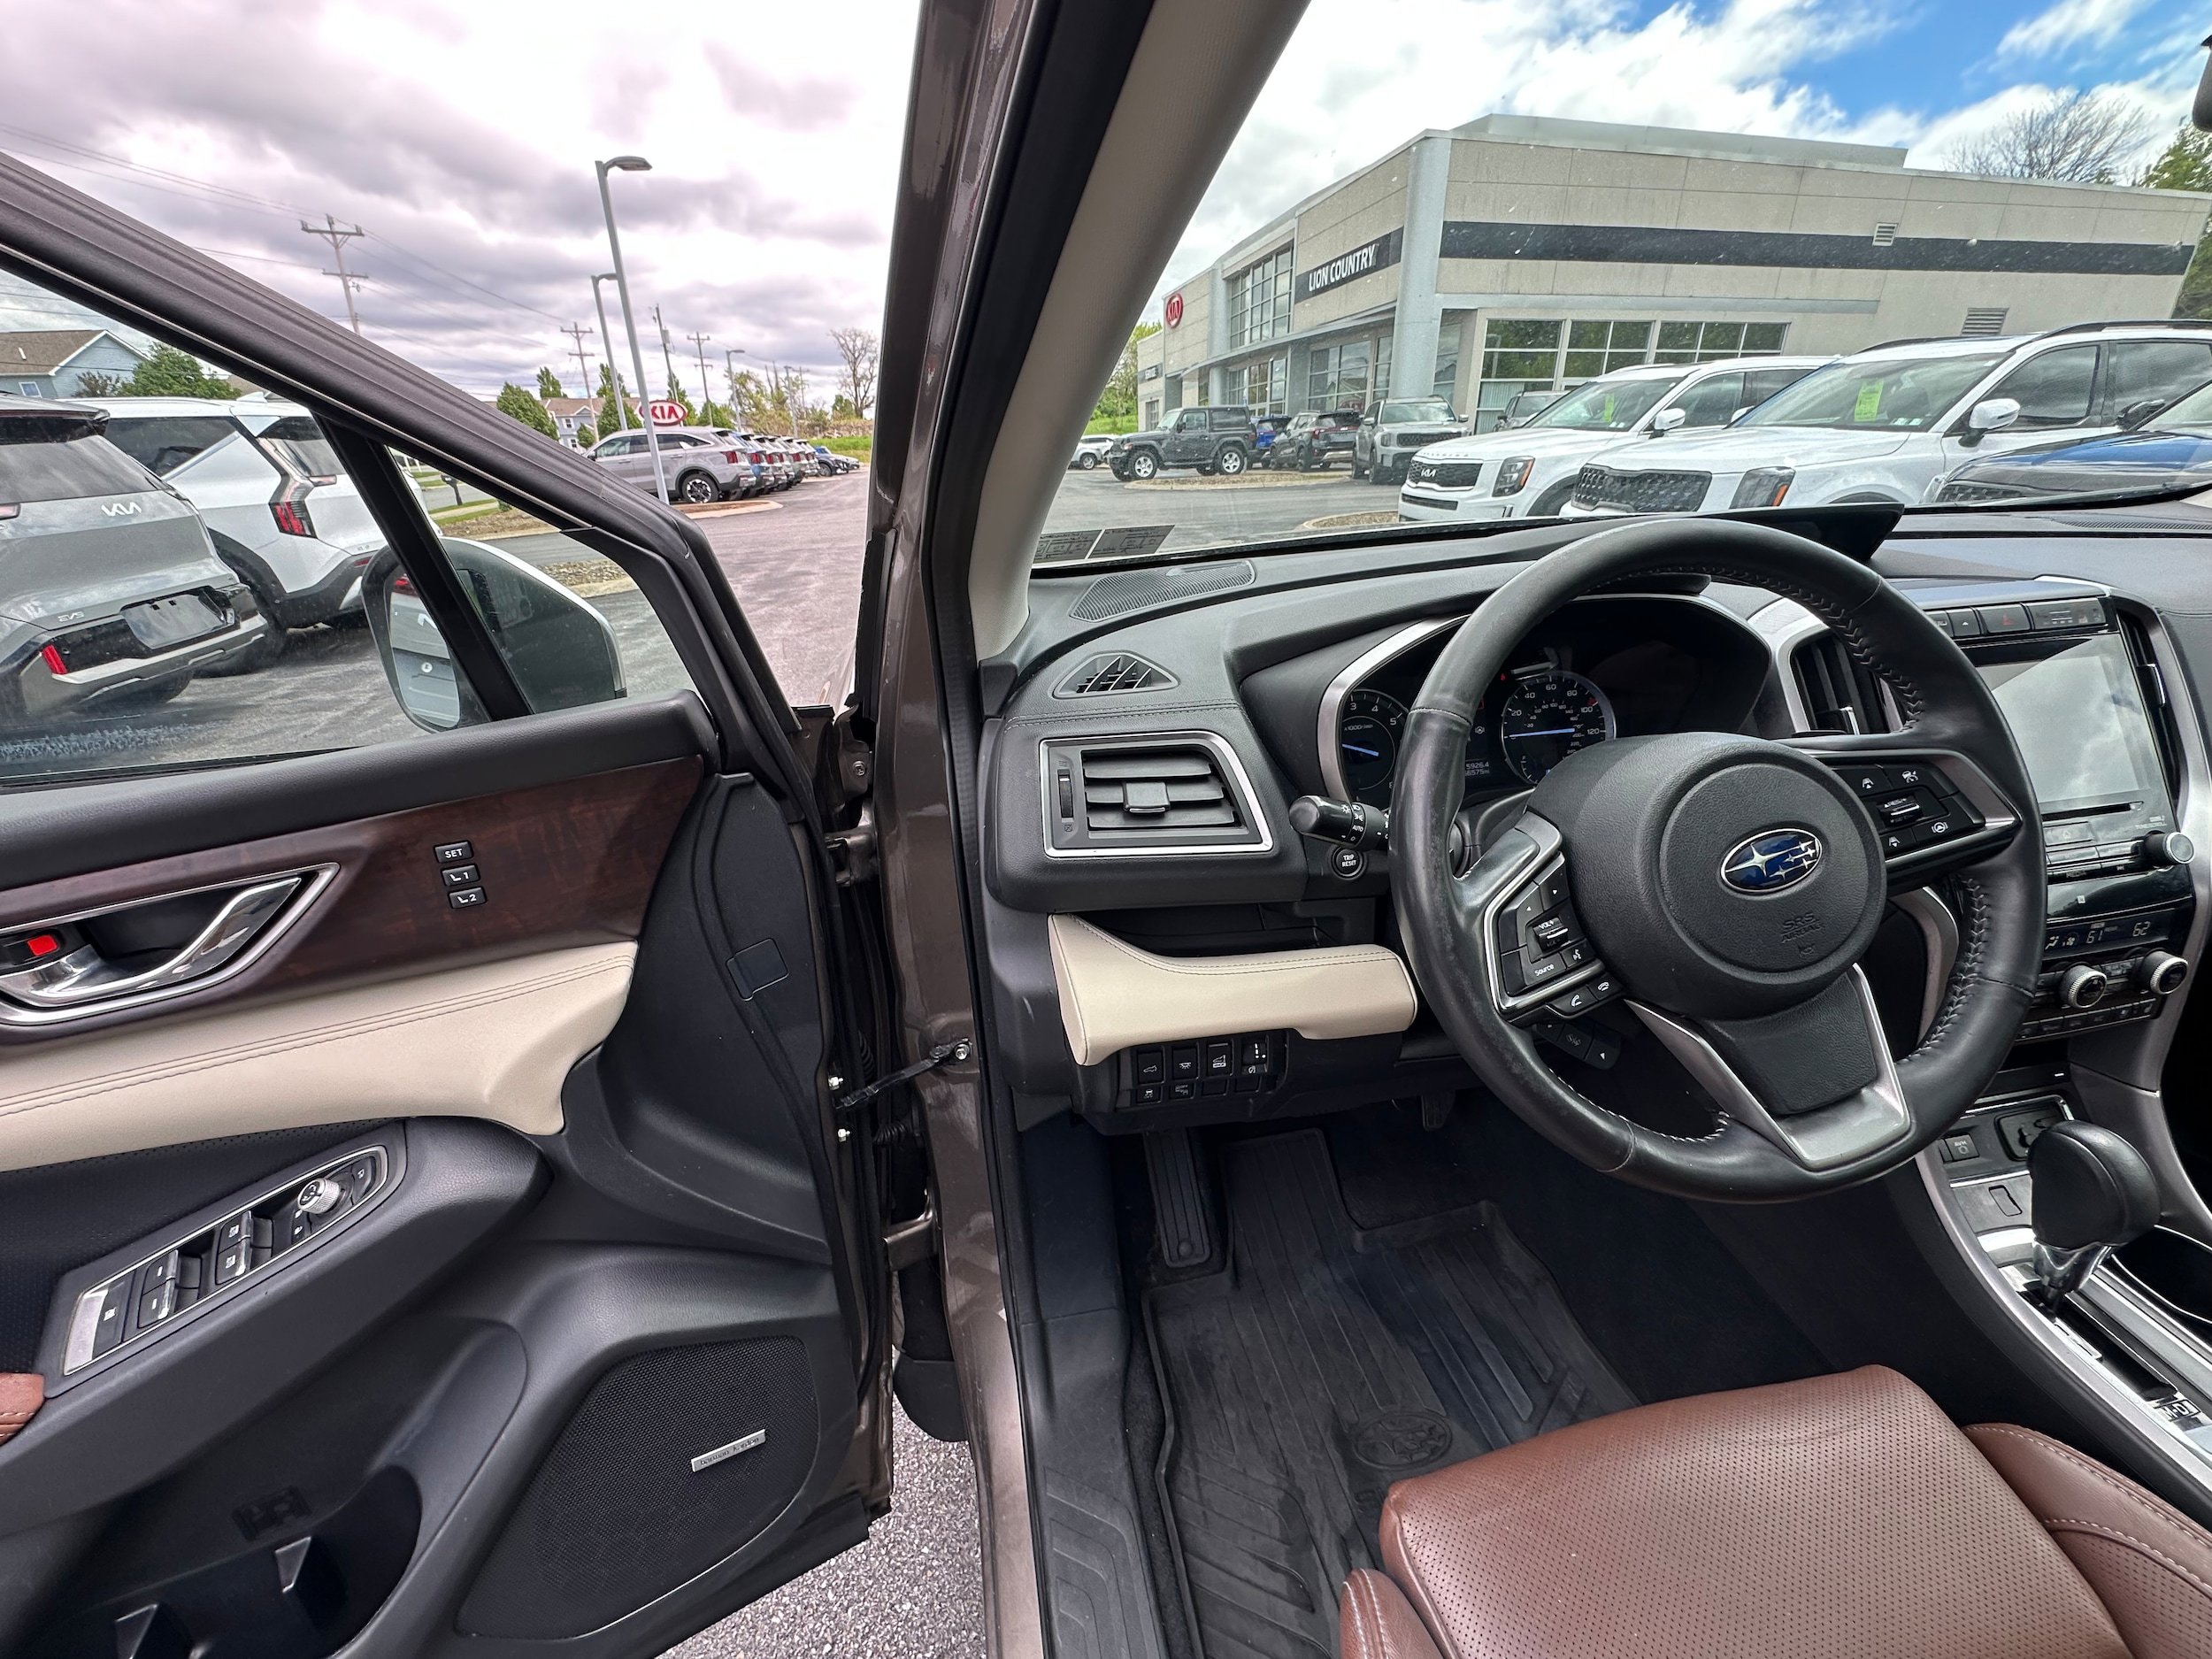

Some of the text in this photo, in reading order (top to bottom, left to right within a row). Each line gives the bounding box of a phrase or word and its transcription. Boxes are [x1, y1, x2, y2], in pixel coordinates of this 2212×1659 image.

[1309, 243, 1376, 292] LION COUNTRY
[1349, 702, 1357, 710] 3
[1389, 717, 1397, 726] 5
[1352, 824, 1364, 833] AUTO
[444, 848, 463, 859] SET
[1341, 859, 1356, 868] RESET
[469, 893, 477, 902] 2
[1782, 912, 1815, 932] SRS
[2132, 920, 2151, 937] 62
[1534, 964, 1555, 977] Source
